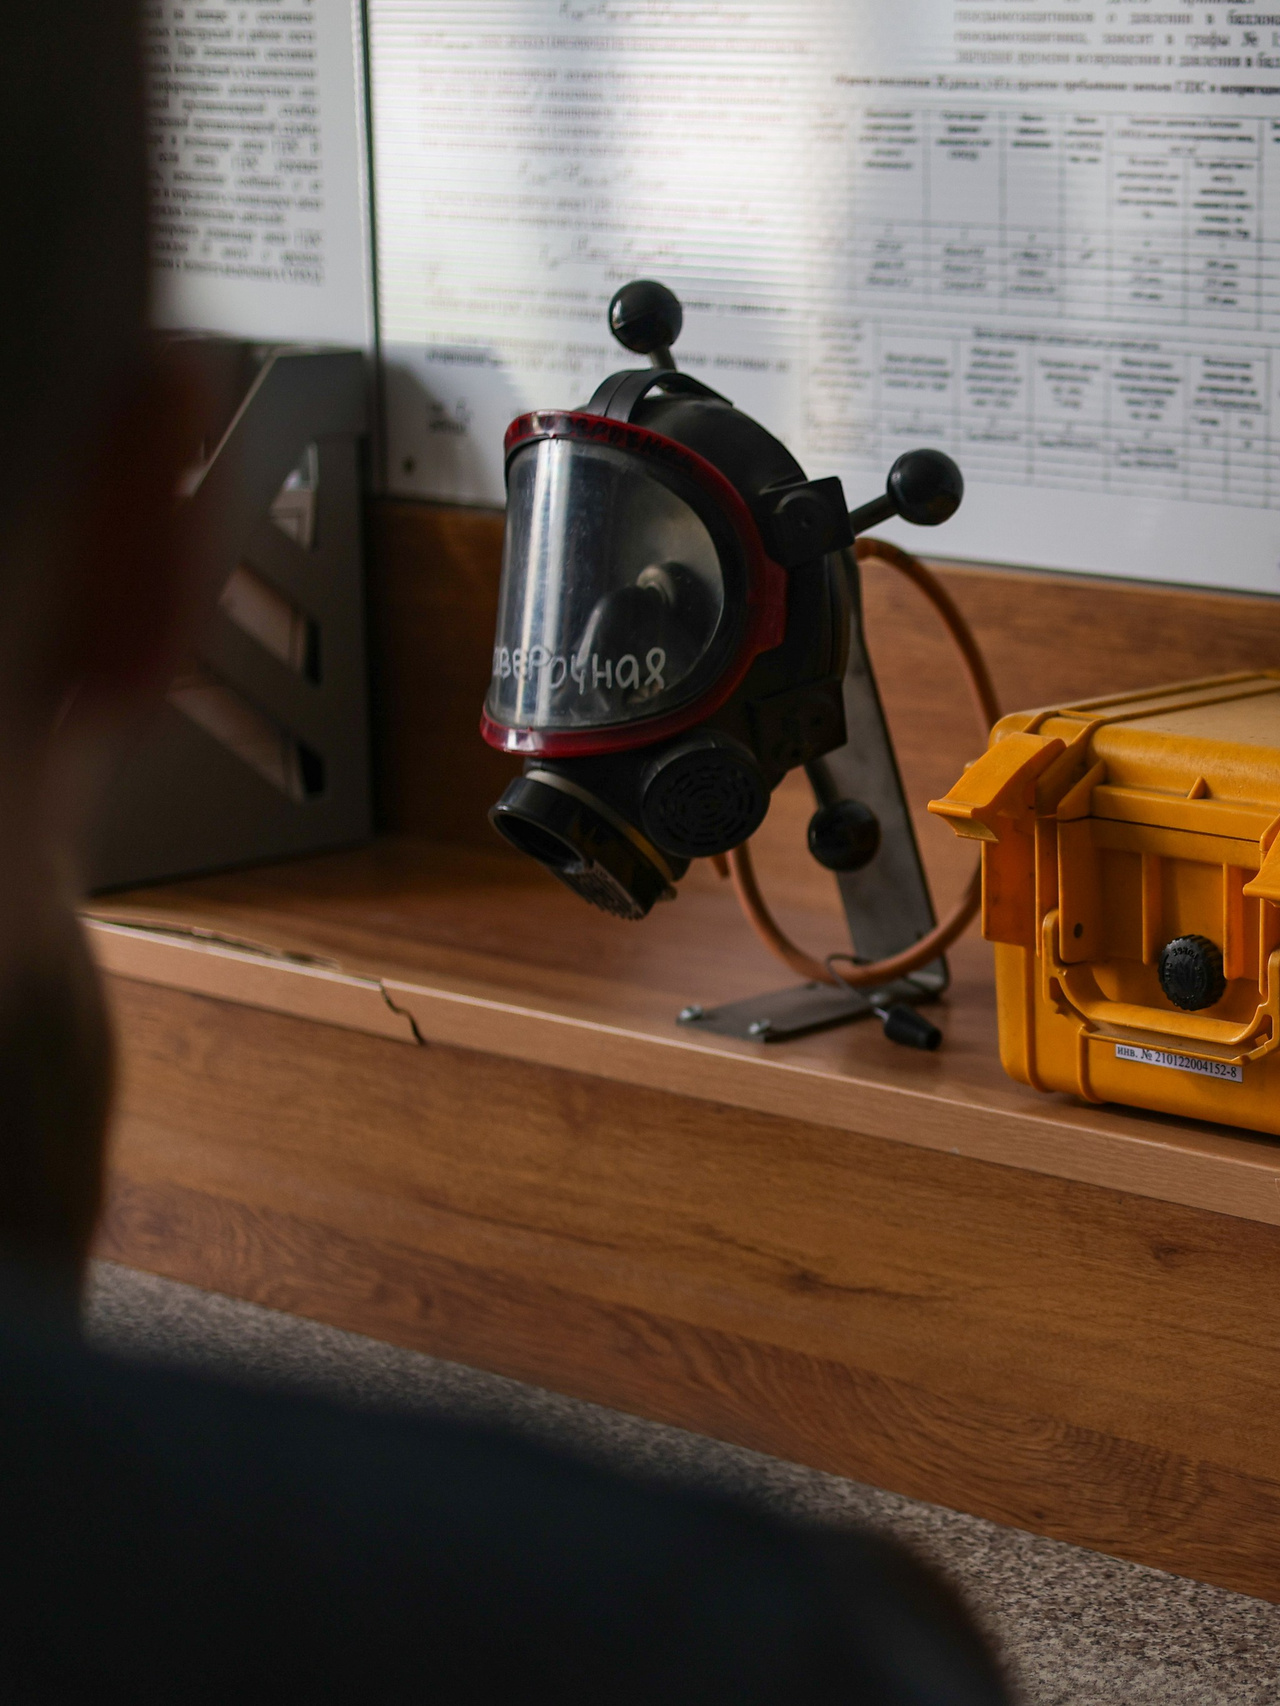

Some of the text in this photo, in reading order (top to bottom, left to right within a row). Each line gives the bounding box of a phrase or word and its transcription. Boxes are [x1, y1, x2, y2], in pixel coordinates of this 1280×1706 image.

[1117, 1046, 1237, 1078] инв. № 210122004152-8
